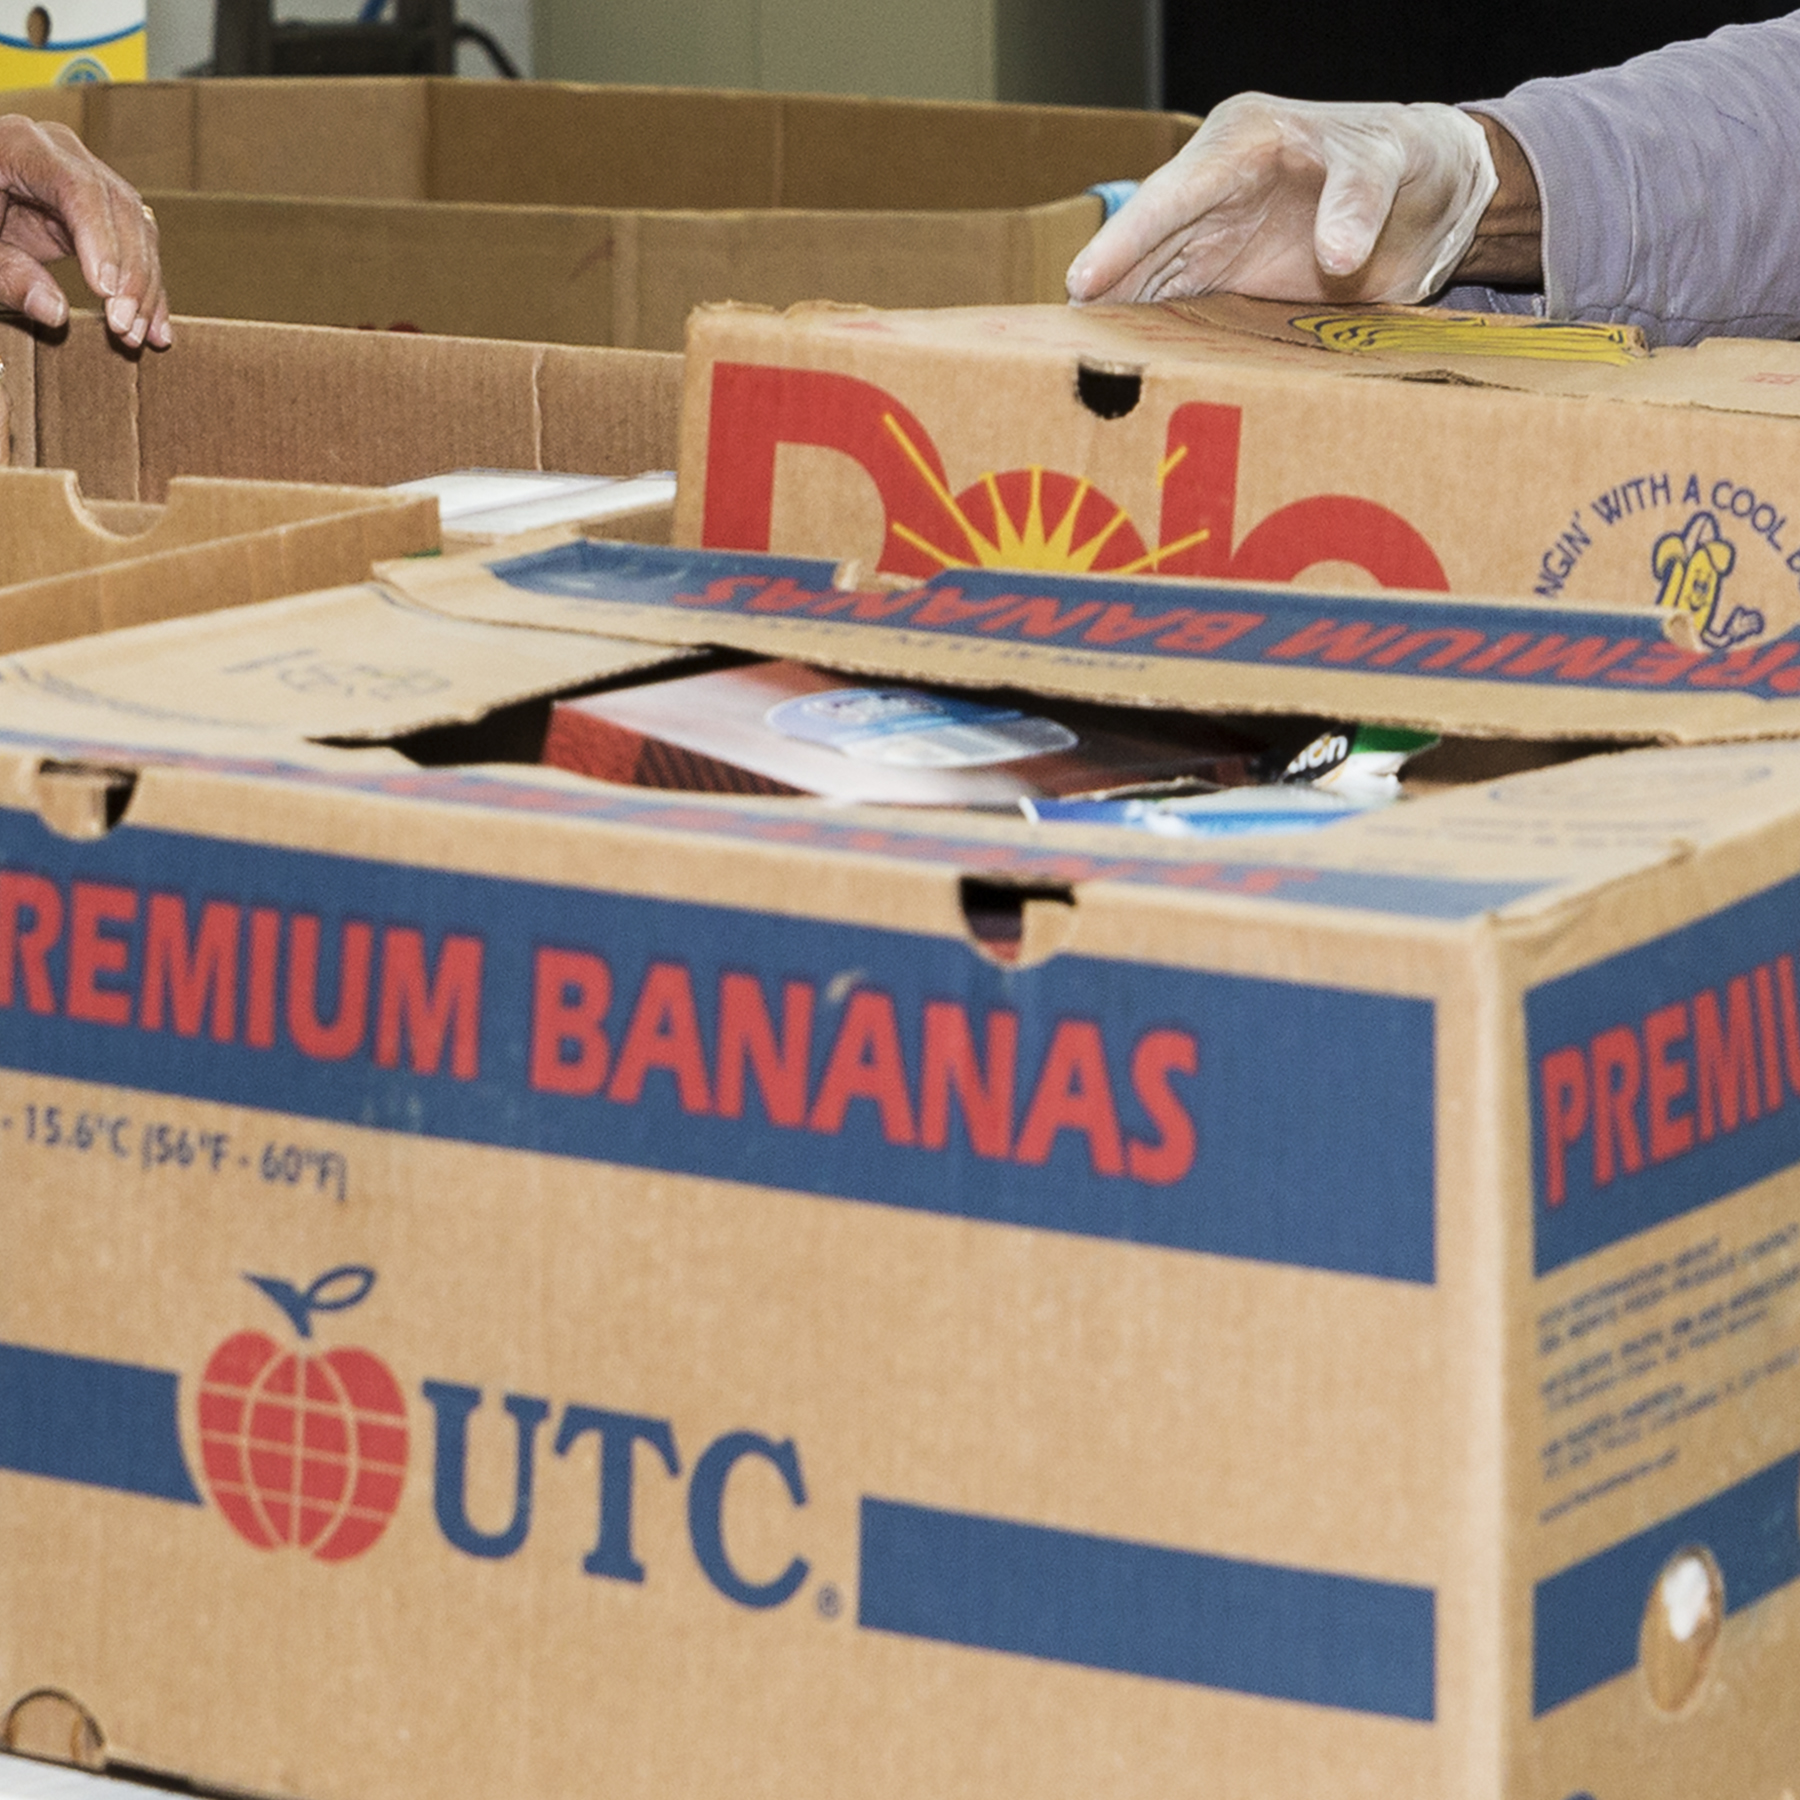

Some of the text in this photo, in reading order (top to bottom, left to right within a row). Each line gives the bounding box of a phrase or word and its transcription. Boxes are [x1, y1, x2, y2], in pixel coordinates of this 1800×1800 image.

[1591, 471, 1672, 528] WITH
[1681, 472, 1701, 506] A
[1710, 478, 1790, 553] COOL
[673, 574, 1266, 654] BANANAS
[528, 943, 1199, 1187] BANANAS
[25, 1103, 129, 1160] 15.6°C
[421, 1375, 810, 1609] UTC
